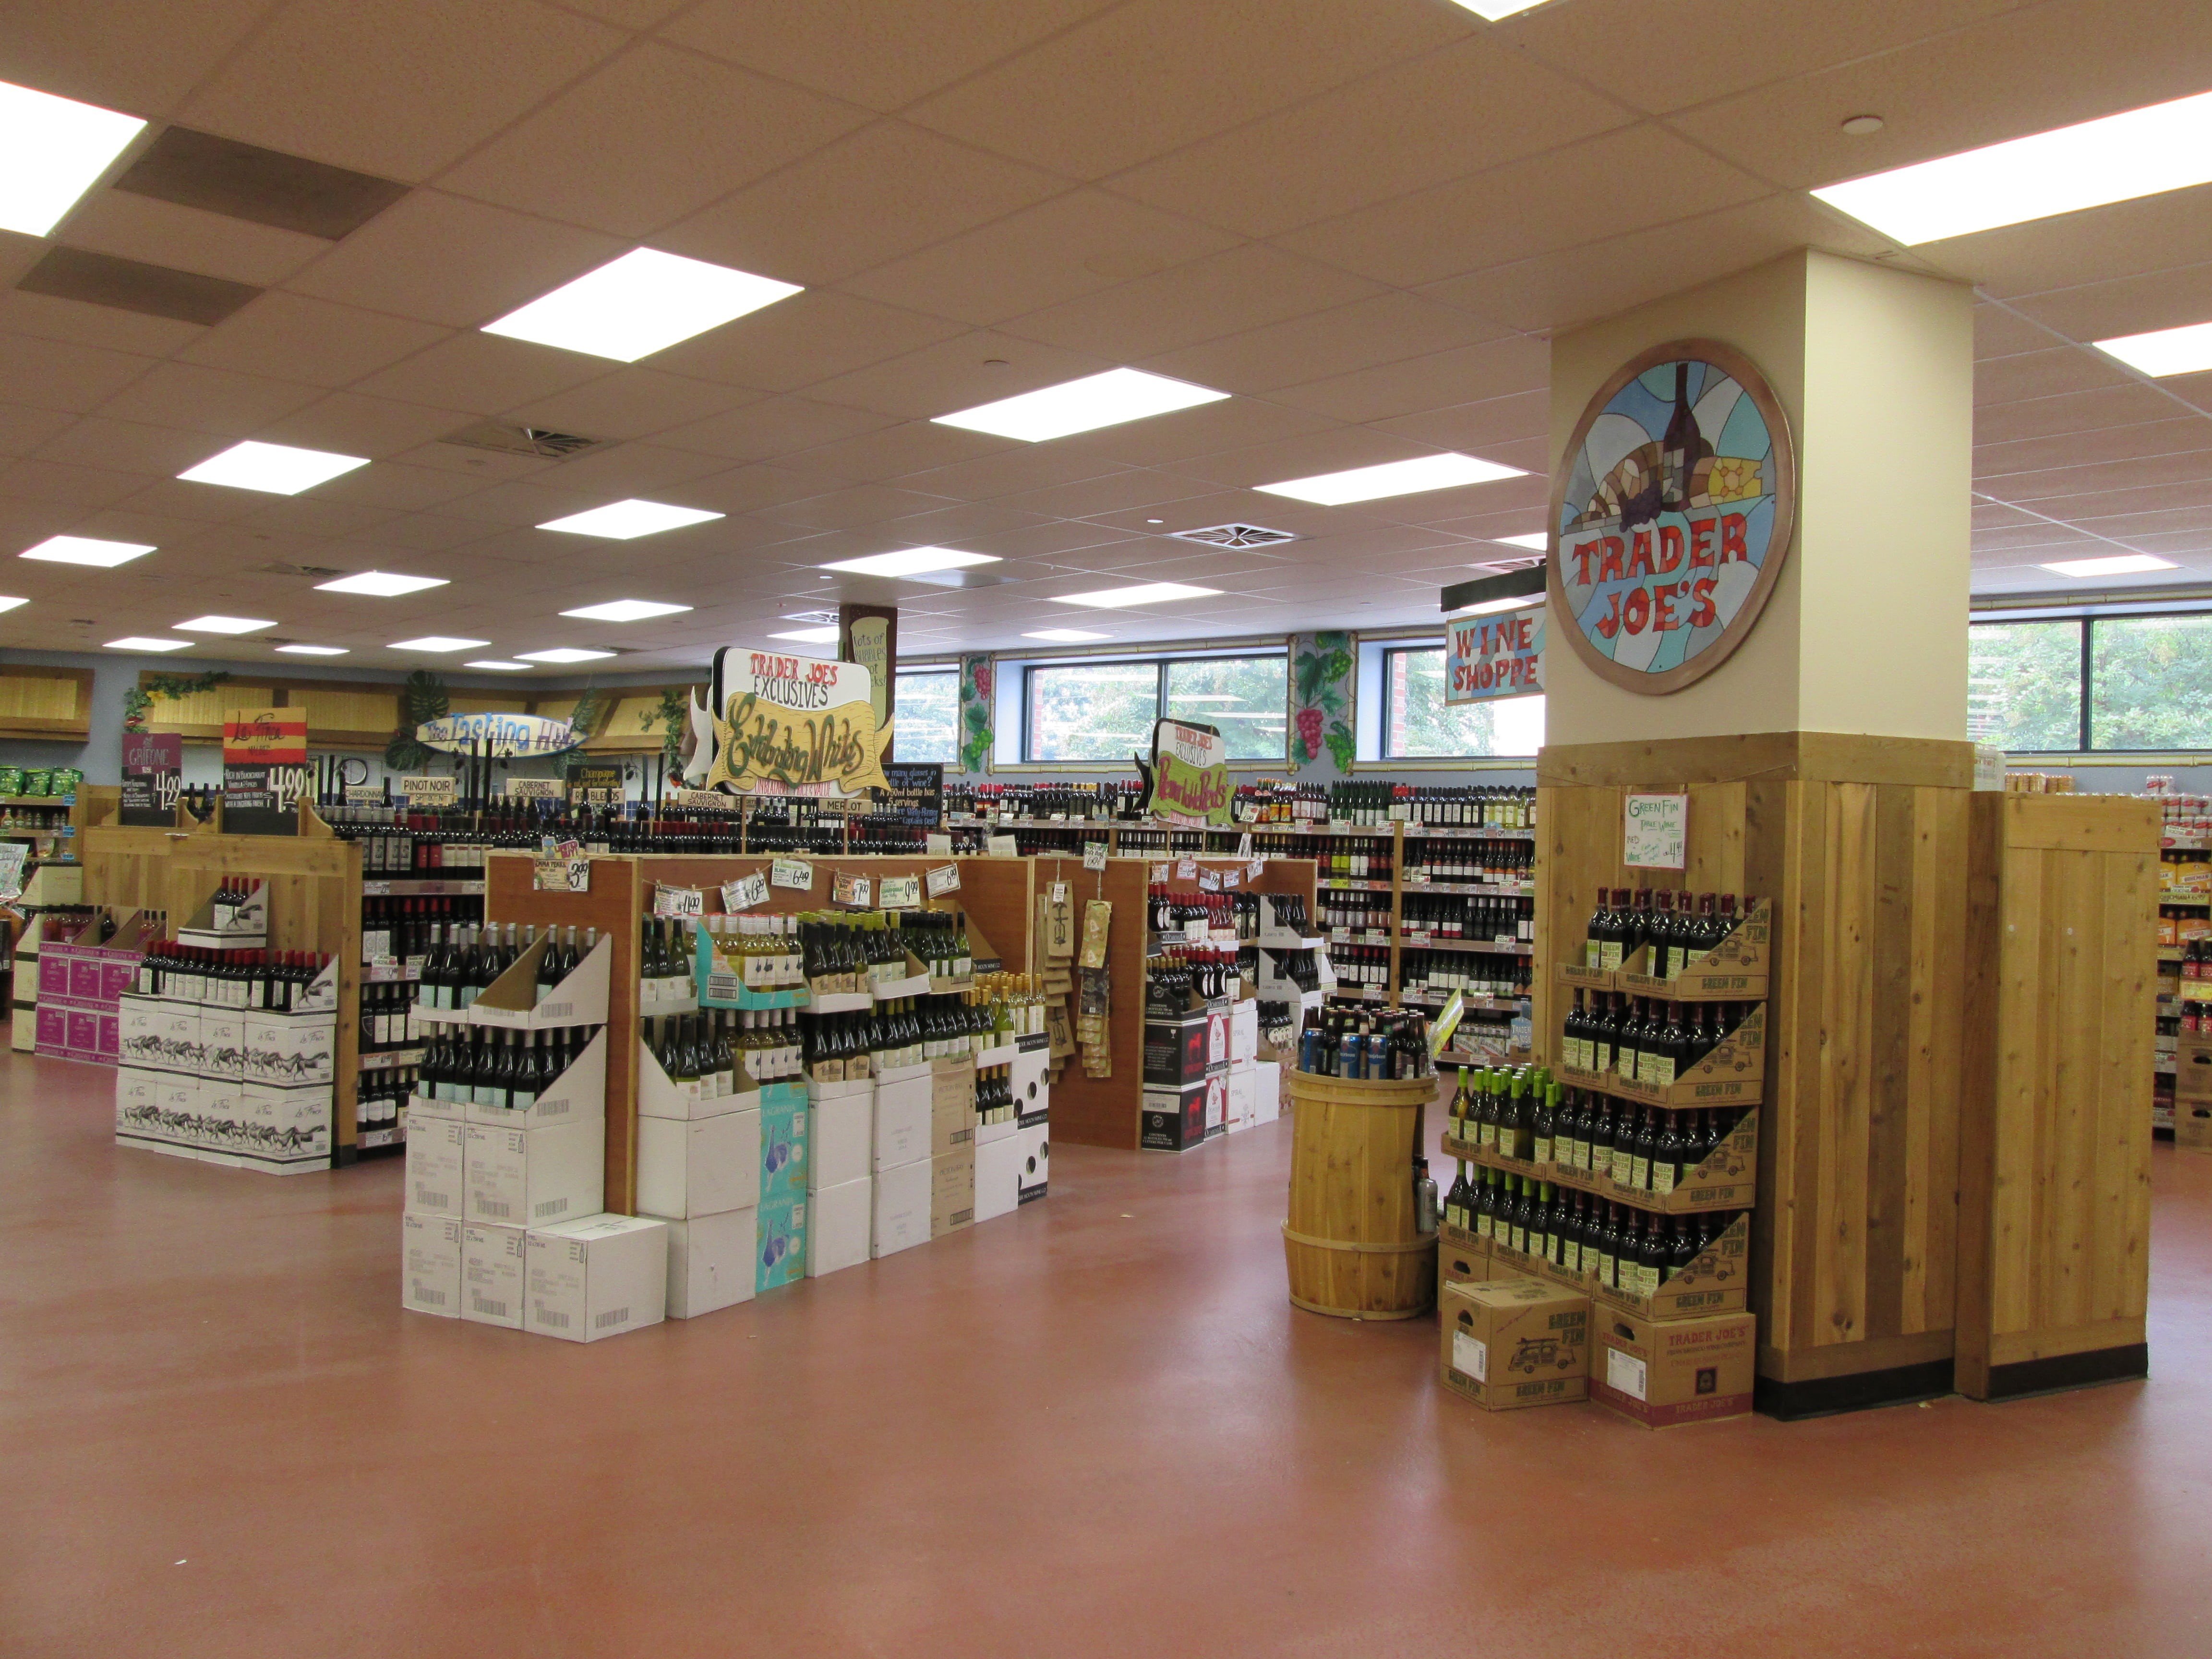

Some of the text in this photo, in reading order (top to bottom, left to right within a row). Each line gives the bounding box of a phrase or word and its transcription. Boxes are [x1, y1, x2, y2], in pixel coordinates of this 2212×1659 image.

[1571, 513, 1749, 586] TRADER
[1596, 577, 1719, 639] JOE'S
[874, 632, 884, 644] of
[1455, 617, 1533, 659] WINE
[751, 653, 839, 686] TRADER JOES
[1453, 655, 1539, 691] SHOPPE
[754, 675, 829, 709] EXCLUSIVES
[425, 713, 576, 751] The Tasting Hut
[804, 714, 864, 781] Whites
[1176, 742, 1207, 766] EXCLUSIVES
[581, 768, 615, 780] Champagne
[891, 769, 908, 781] many
[912, 776, 932, 786] wine?
[404, 780, 451, 791] PINOT NOIR
[515, 788, 553, 796] SAUVIGNON
[518, 781, 550, 789] CABERNET
[814, 781, 831, 797] VALUE
[906, 788, 922, 796] bottle
[924, 788, 935, 796] has
[687, 799, 726, 807] SAUVIGNON
[691, 792, 725, 801] CABERNET
[1629, 799, 1679, 818] GREEN FIN
[1627, 836, 1639, 844] RED
[1746, 925, 1767, 943] FIN
[1702, 977, 1748, 990] GREEN FIN
[1739, 1031, 1762, 1046] FIN
[1695, 1082, 1742, 1097] GREEN FIN
[1733, 1134, 1755, 1150] FIN
[1721, 1239, 1744, 1256] FIN
[1549, 1310, 1586, 1330] GREEN
[1562, 1327, 1585, 1344] FIN
[1669, 1326, 1745, 1346] TRADER JOE'S
